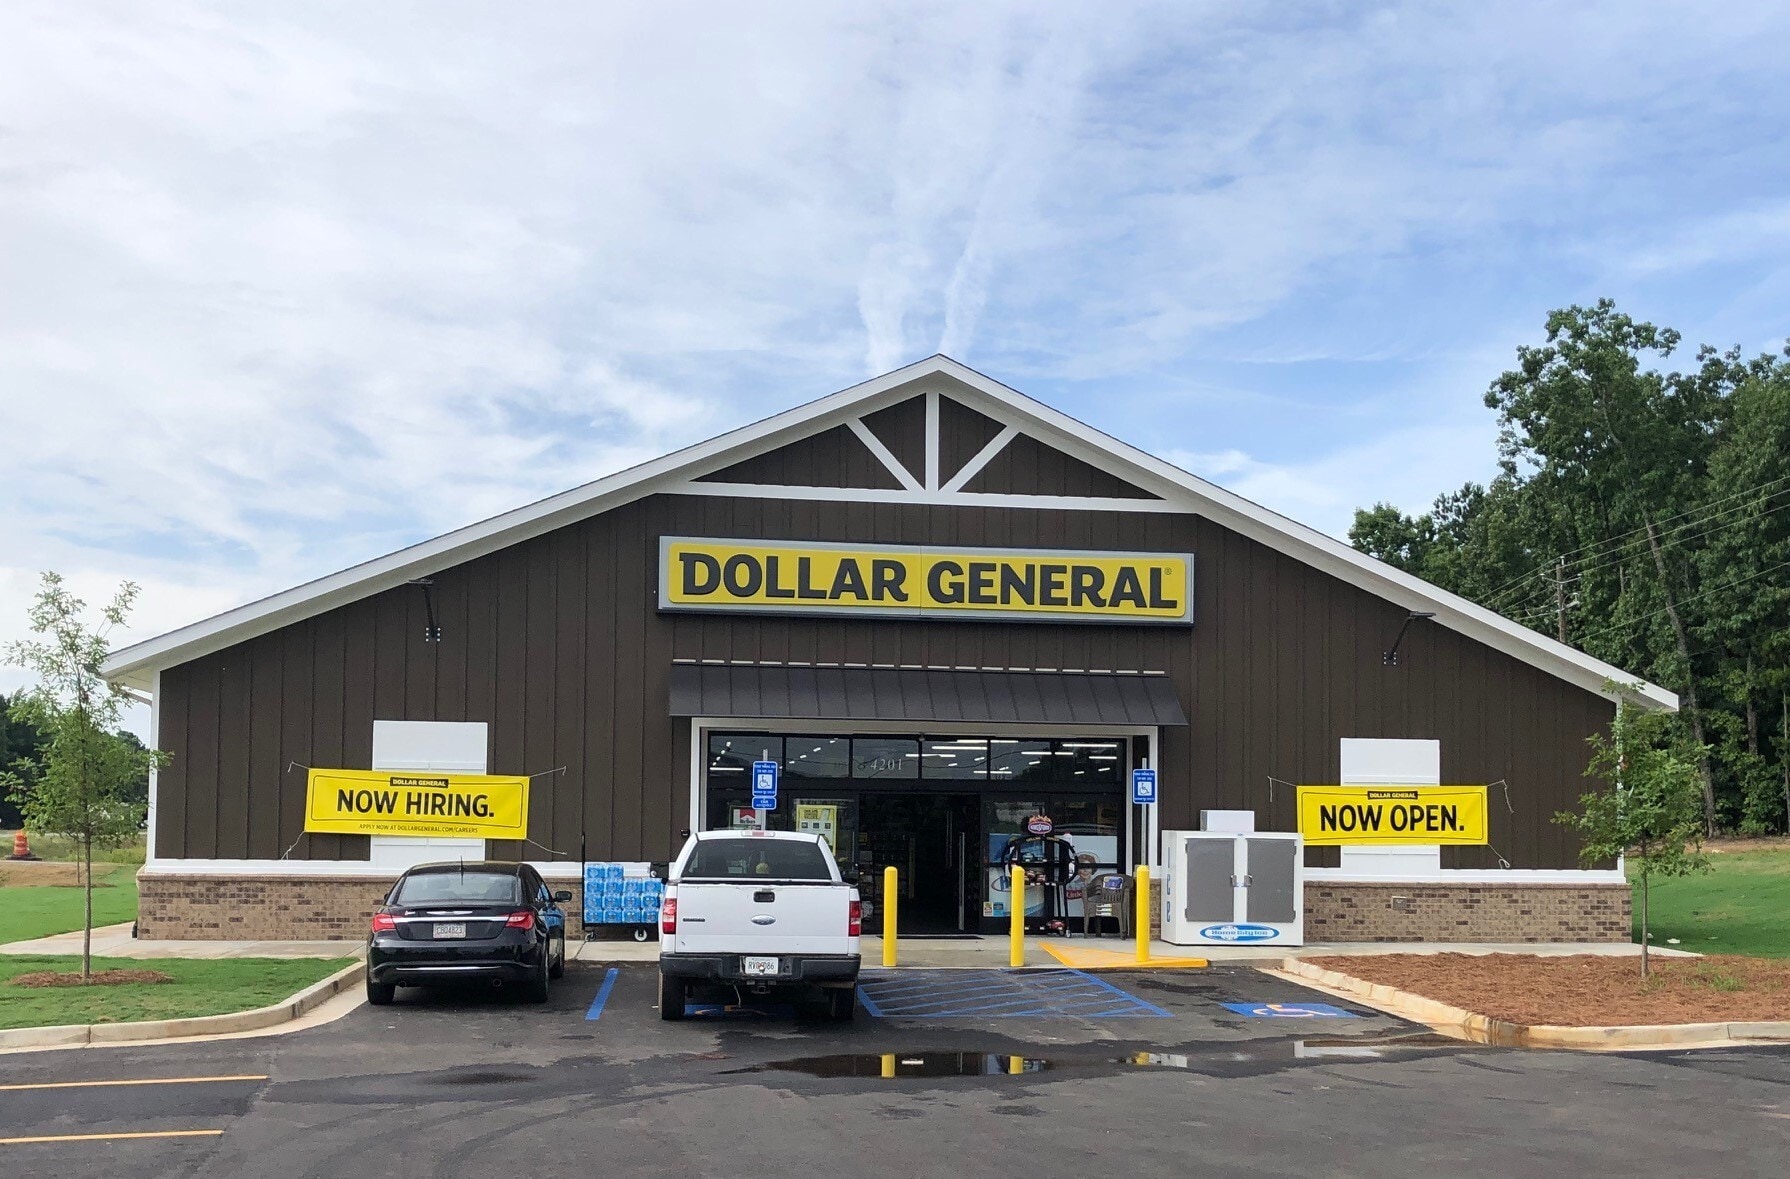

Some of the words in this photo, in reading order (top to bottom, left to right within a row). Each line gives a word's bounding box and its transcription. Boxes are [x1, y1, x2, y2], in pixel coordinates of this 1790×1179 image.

[679, 551, 909, 602] DOLLAR
[927, 560, 1178, 610] GENERAL
[870, 758, 902, 770] 4201
[337, 789, 399, 814] NOW
[406, 792, 494, 818] HIRING.
[1320, 804, 1383, 832] NOW
[1390, 804, 1465, 832] OPEN.
